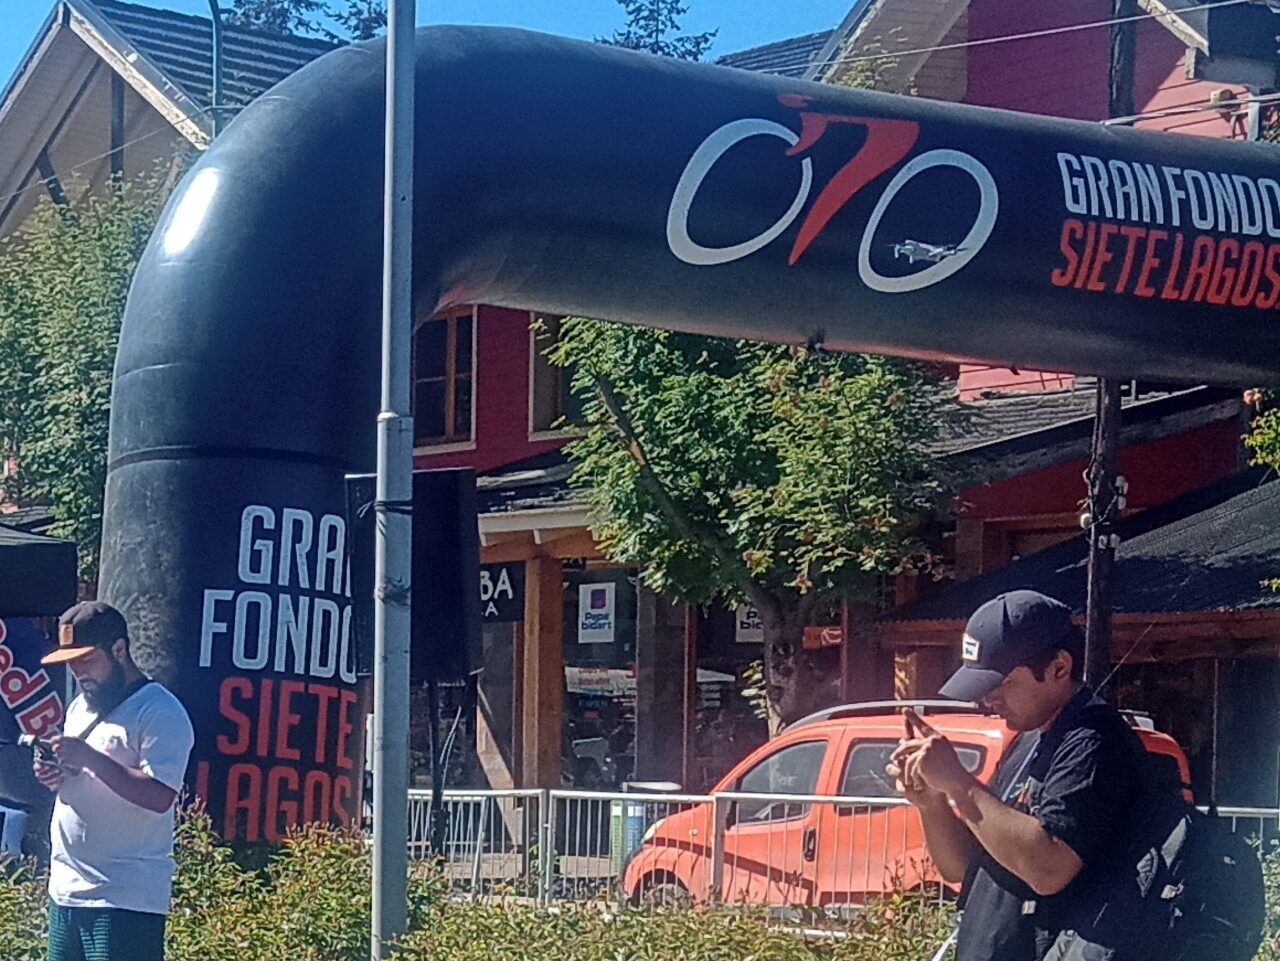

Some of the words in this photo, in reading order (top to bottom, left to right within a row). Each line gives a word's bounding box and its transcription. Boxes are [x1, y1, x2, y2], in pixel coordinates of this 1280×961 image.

[1056, 152, 1164, 225] GRAN
[1051, 218, 1169, 298] SIETE
[237, 504, 352, 598] GRA
[216, 676, 358, 769] SIETE
